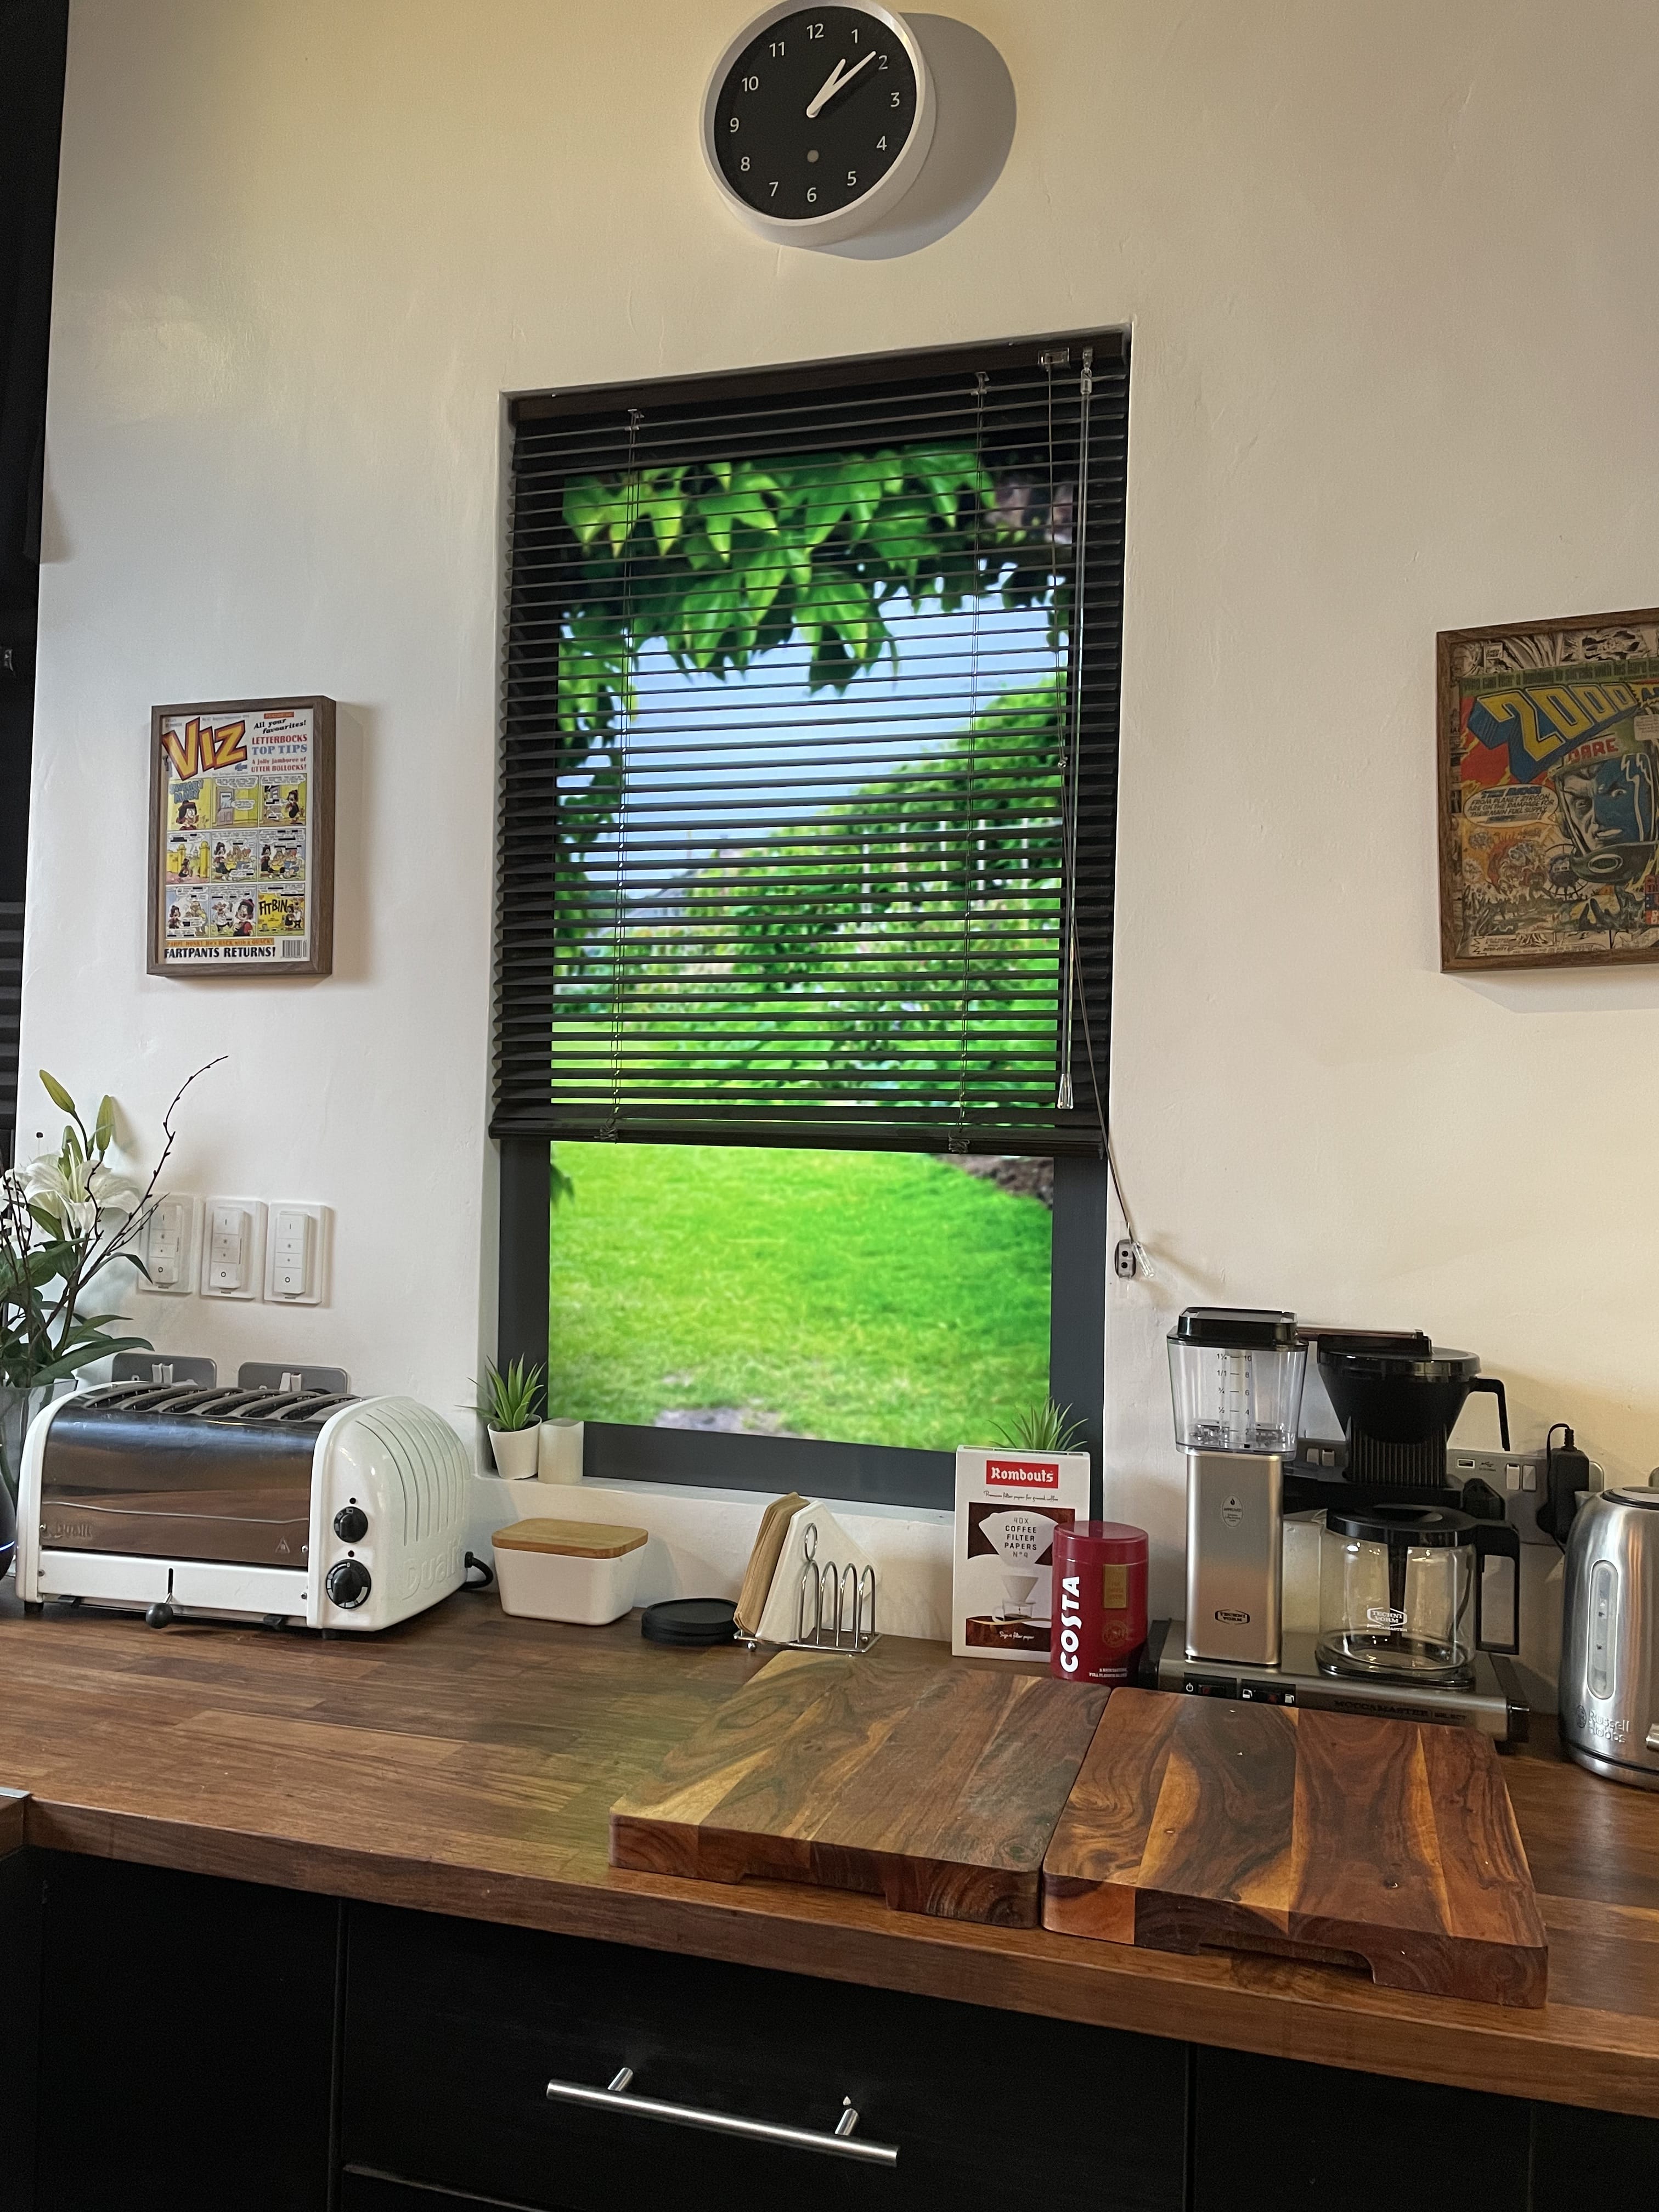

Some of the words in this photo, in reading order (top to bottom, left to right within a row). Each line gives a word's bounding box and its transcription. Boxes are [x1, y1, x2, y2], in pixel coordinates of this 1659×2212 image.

[806, 23, 824, 40] 12
[851, 29, 859, 43] 1
[769, 42, 785, 57] 11
[878, 55, 888, 70] 2
[741, 76, 759, 92] 10
[890, 92, 900, 108] 3
[730, 117, 740, 132] 9
[876, 136, 887, 151] 4
[741, 156, 751, 171] 8
[847, 171, 857, 186] 5
[769, 181, 779, 196] 7
[807, 187, 817, 202] 6
[253, 721, 264, 730] All
[268, 719, 286, 728] your
[263, 720, 306, 734] favourites!
[1476, 682, 1639, 761] 2000
[252, 734, 307, 745] LETTERBOCKS
[252, 746, 275, 755] TOP
[278, 744, 307, 754] TIPS
[1568, 737, 1619, 764] DARE
[272, 764, 307, 772] BOLLOCKS!
[1493, 796, 1519, 804] PLANET
[1520, 793, 1550, 802] ZIRCON
[1507, 800, 1540, 808] RAMPAGE
[164, 947, 219, 958] FARTPANTS
[224, 946, 275, 957] RETURNS!
[991, 1466, 1054, 1482] Rombouts
[1005, 1525, 1036, 1533] COFFEE
[1005, 1542, 1037, 1550] PAPERS
[1372, 1610, 1403, 1619] TECHNI
[1060, 1576, 1082, 1672] COSTA
[1335, 1701, 1428, 1717] MOCCAMASTER
[1589, 1709, 1629, 1733] Russell
[1588, 1720, 1626, 1742] Hobbs
